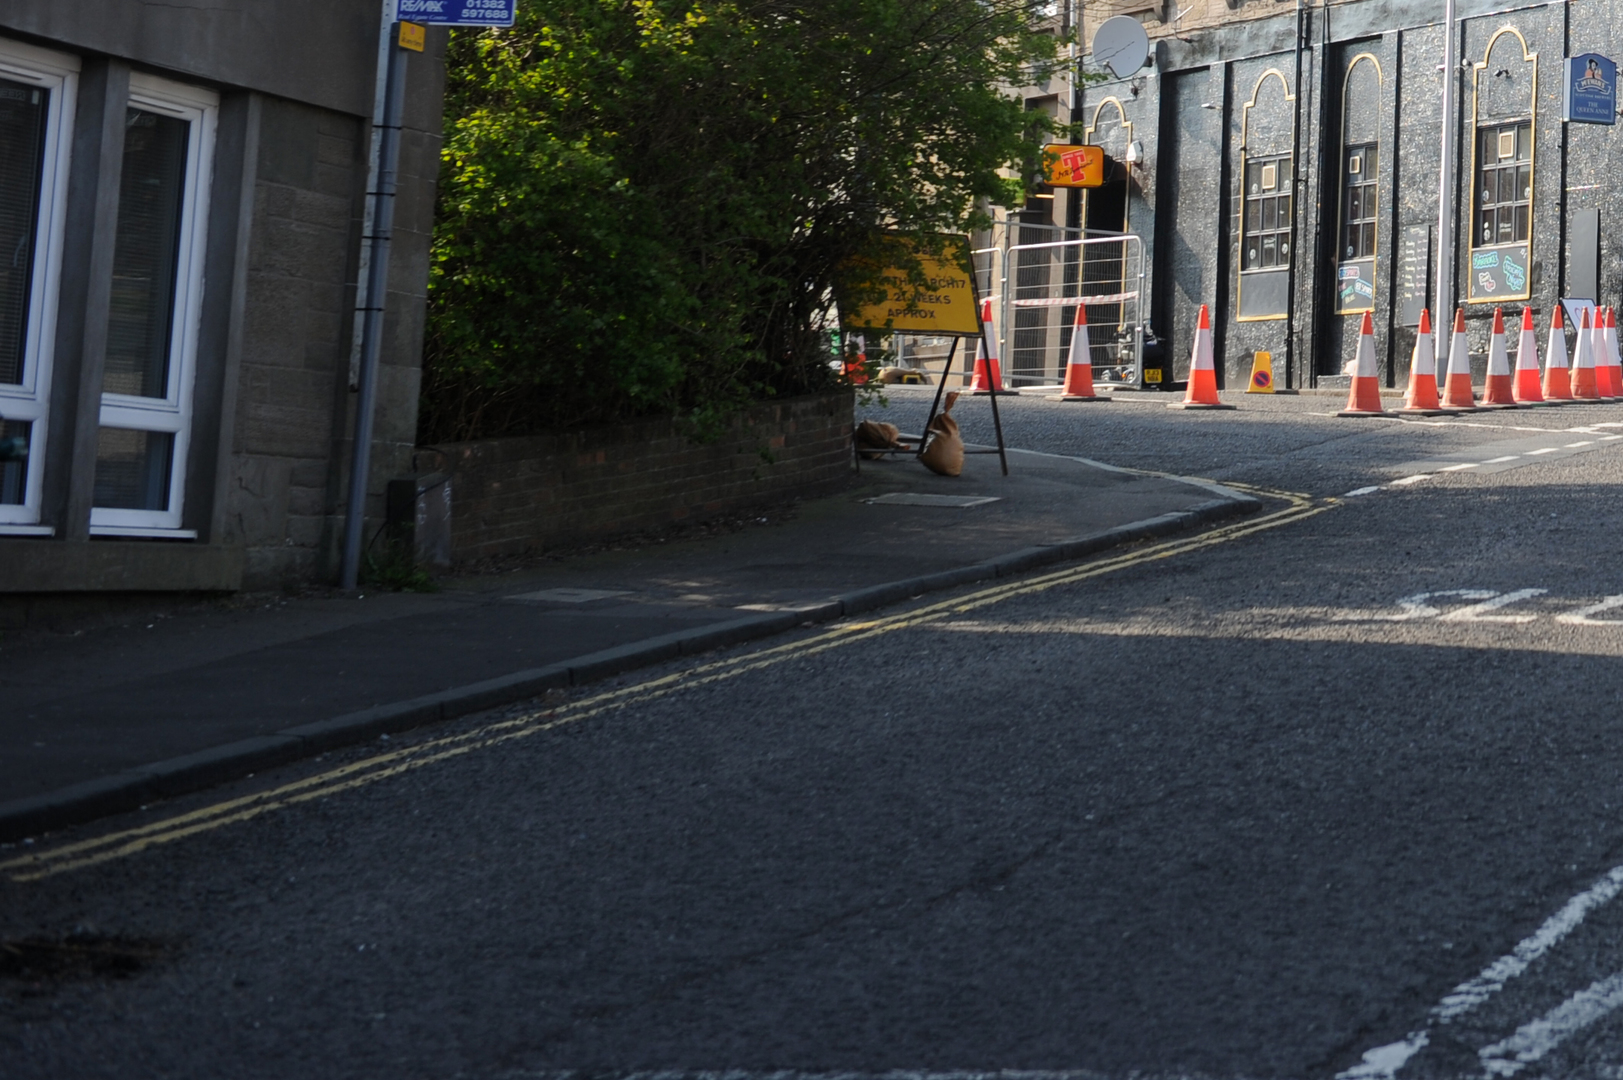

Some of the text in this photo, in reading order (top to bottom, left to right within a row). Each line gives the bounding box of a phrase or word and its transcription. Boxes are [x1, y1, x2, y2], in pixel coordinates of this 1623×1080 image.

[400, 0, 444, 12] RE/MAX
[466, 0, 506, 9] 01382
[461, 8, 509, 19] 597688
[1576, 106, 1609, 116] QUEEN ANNE
[887, 307, 937, 320] APPROX
